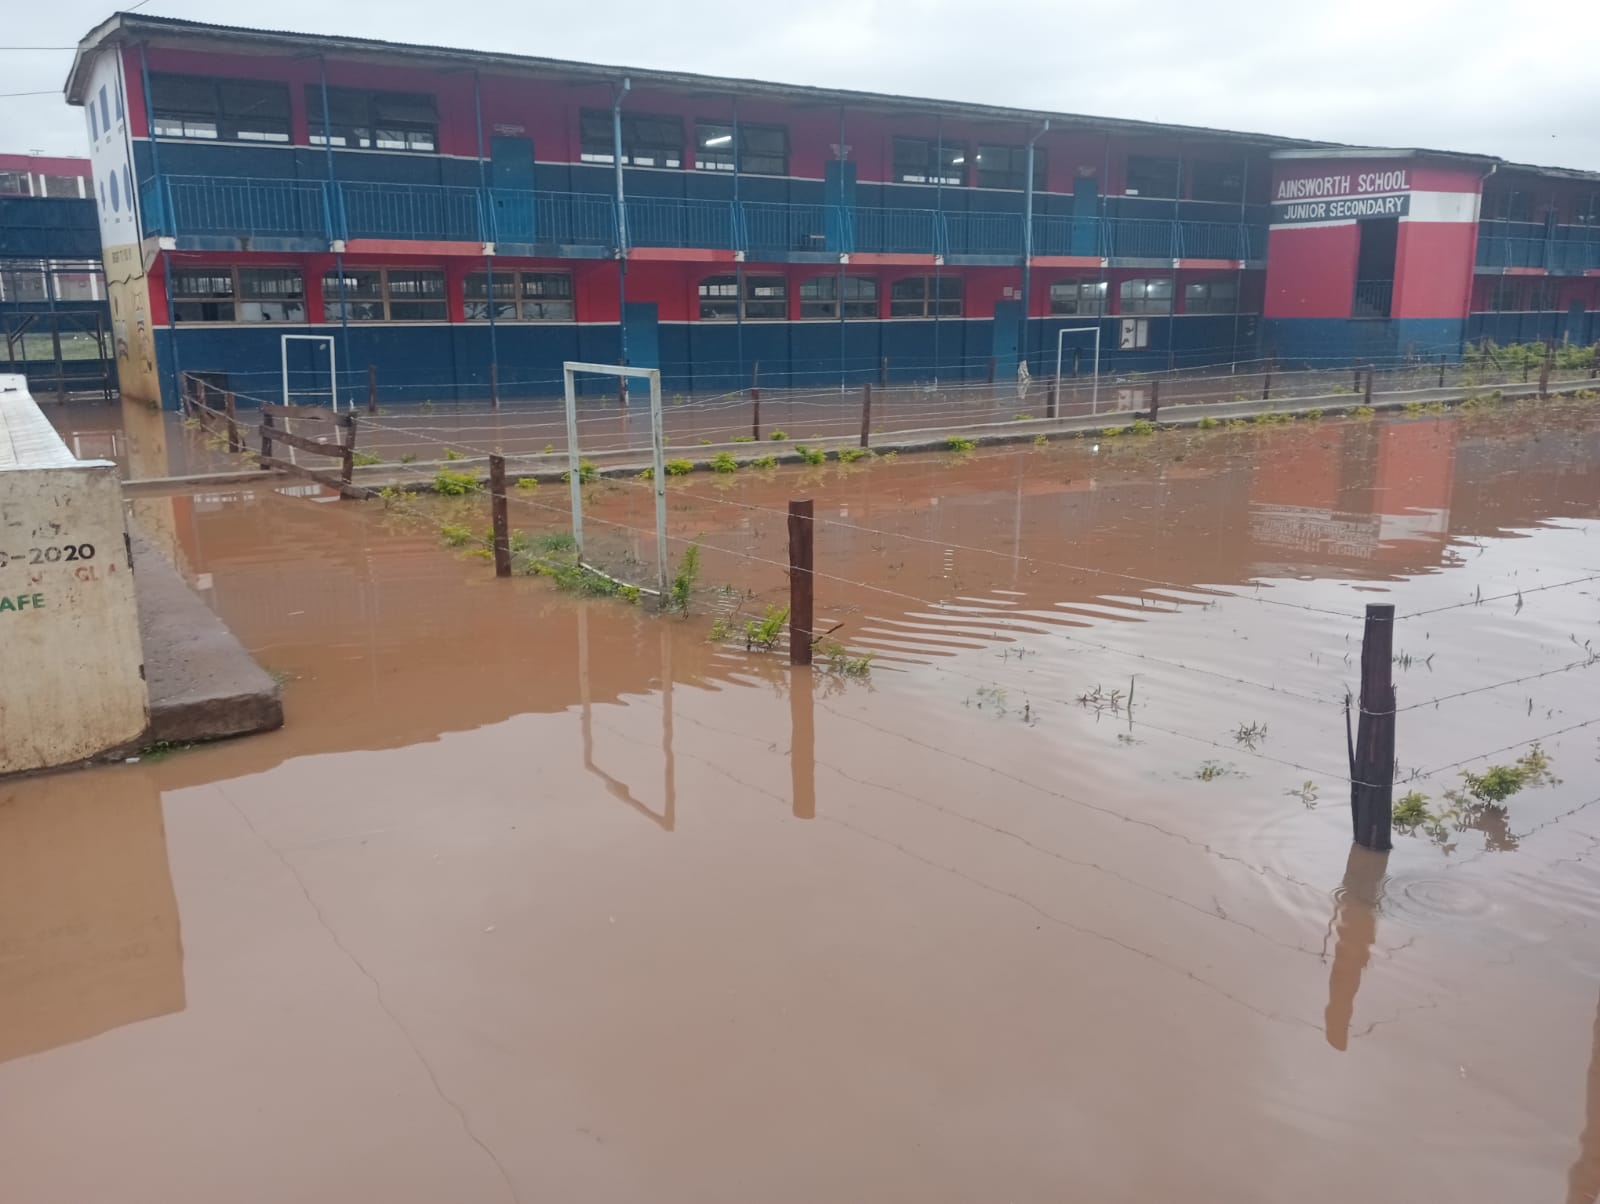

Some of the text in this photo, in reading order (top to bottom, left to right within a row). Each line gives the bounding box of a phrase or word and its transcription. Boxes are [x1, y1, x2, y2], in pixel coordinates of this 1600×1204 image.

[1278, 170, 1410, 198] AINSWORTH SCHOOL
[1284, 197, 1404, 219] JUNIOR SECONDARY
